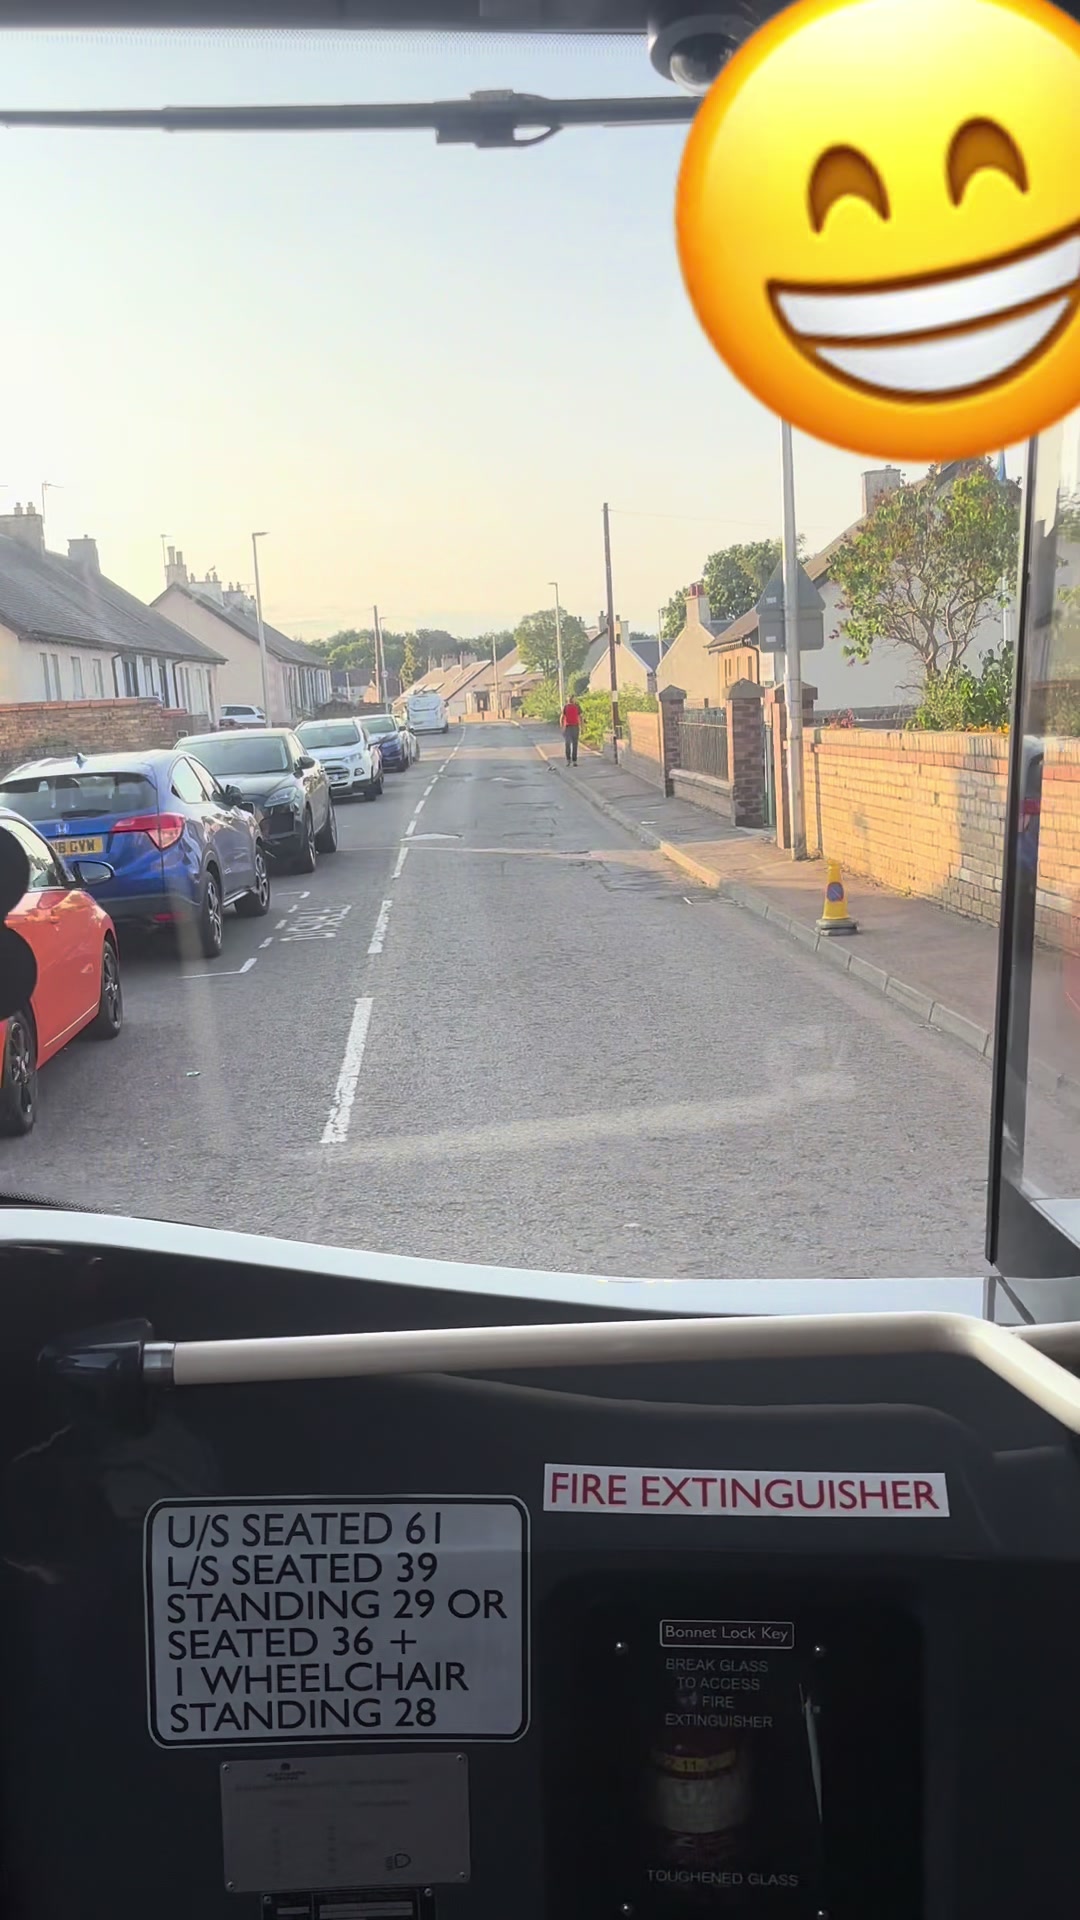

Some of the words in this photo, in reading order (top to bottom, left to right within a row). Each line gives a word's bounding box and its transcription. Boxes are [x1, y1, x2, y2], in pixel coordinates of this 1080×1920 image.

[551, 1472, 627, 1505] FIRE
[642, 1475, 940, 1510] EXTINGUISHER
[167, 1513, 229, 1551] U/S
[242, 1512, 393, 1547] SEATED
[406, 1511, 442, 1545] 61
[167, 1554, 219, 1590] L/S
[231, 1552, 383, 1586] SEATED
[396, 1552, 438, 1583] 39
[167, 1590, 380, 1624] STANDING
[393, 1588, 435, 1620] 29
[448, 1588, 508, 1619] OR
[168, 1627, 319, 1660] SEATED
[332, 1625, 374, 1656] 36
[390, 1629, 417, 1655] +
[665, 1625, 717, 1639] Bonnet
[721, 1626, 756, 1639] Lock
[761, 1627, 789, 1642] Key
[200, 1662, 469, 1695] WHEELCHAIR
[665, 1658, 716, 1671] BREAK
[719, 1659, 769, 1673] GLASS
[677, 1676, 696, 1689] TO
[700, 1677, 761, 1691] ACCESS
[170, 1698, 381, 1733] STANDING
[394, 1697, 437, 1727] 28
[702, 1695, 735, 1709] FIRE
[665, 1713, 774, 1728] EXTINGUISHER
[647, 1869, 743, 1885] TOUGHENED
[747, 1872, 800, 1887] GLASS
